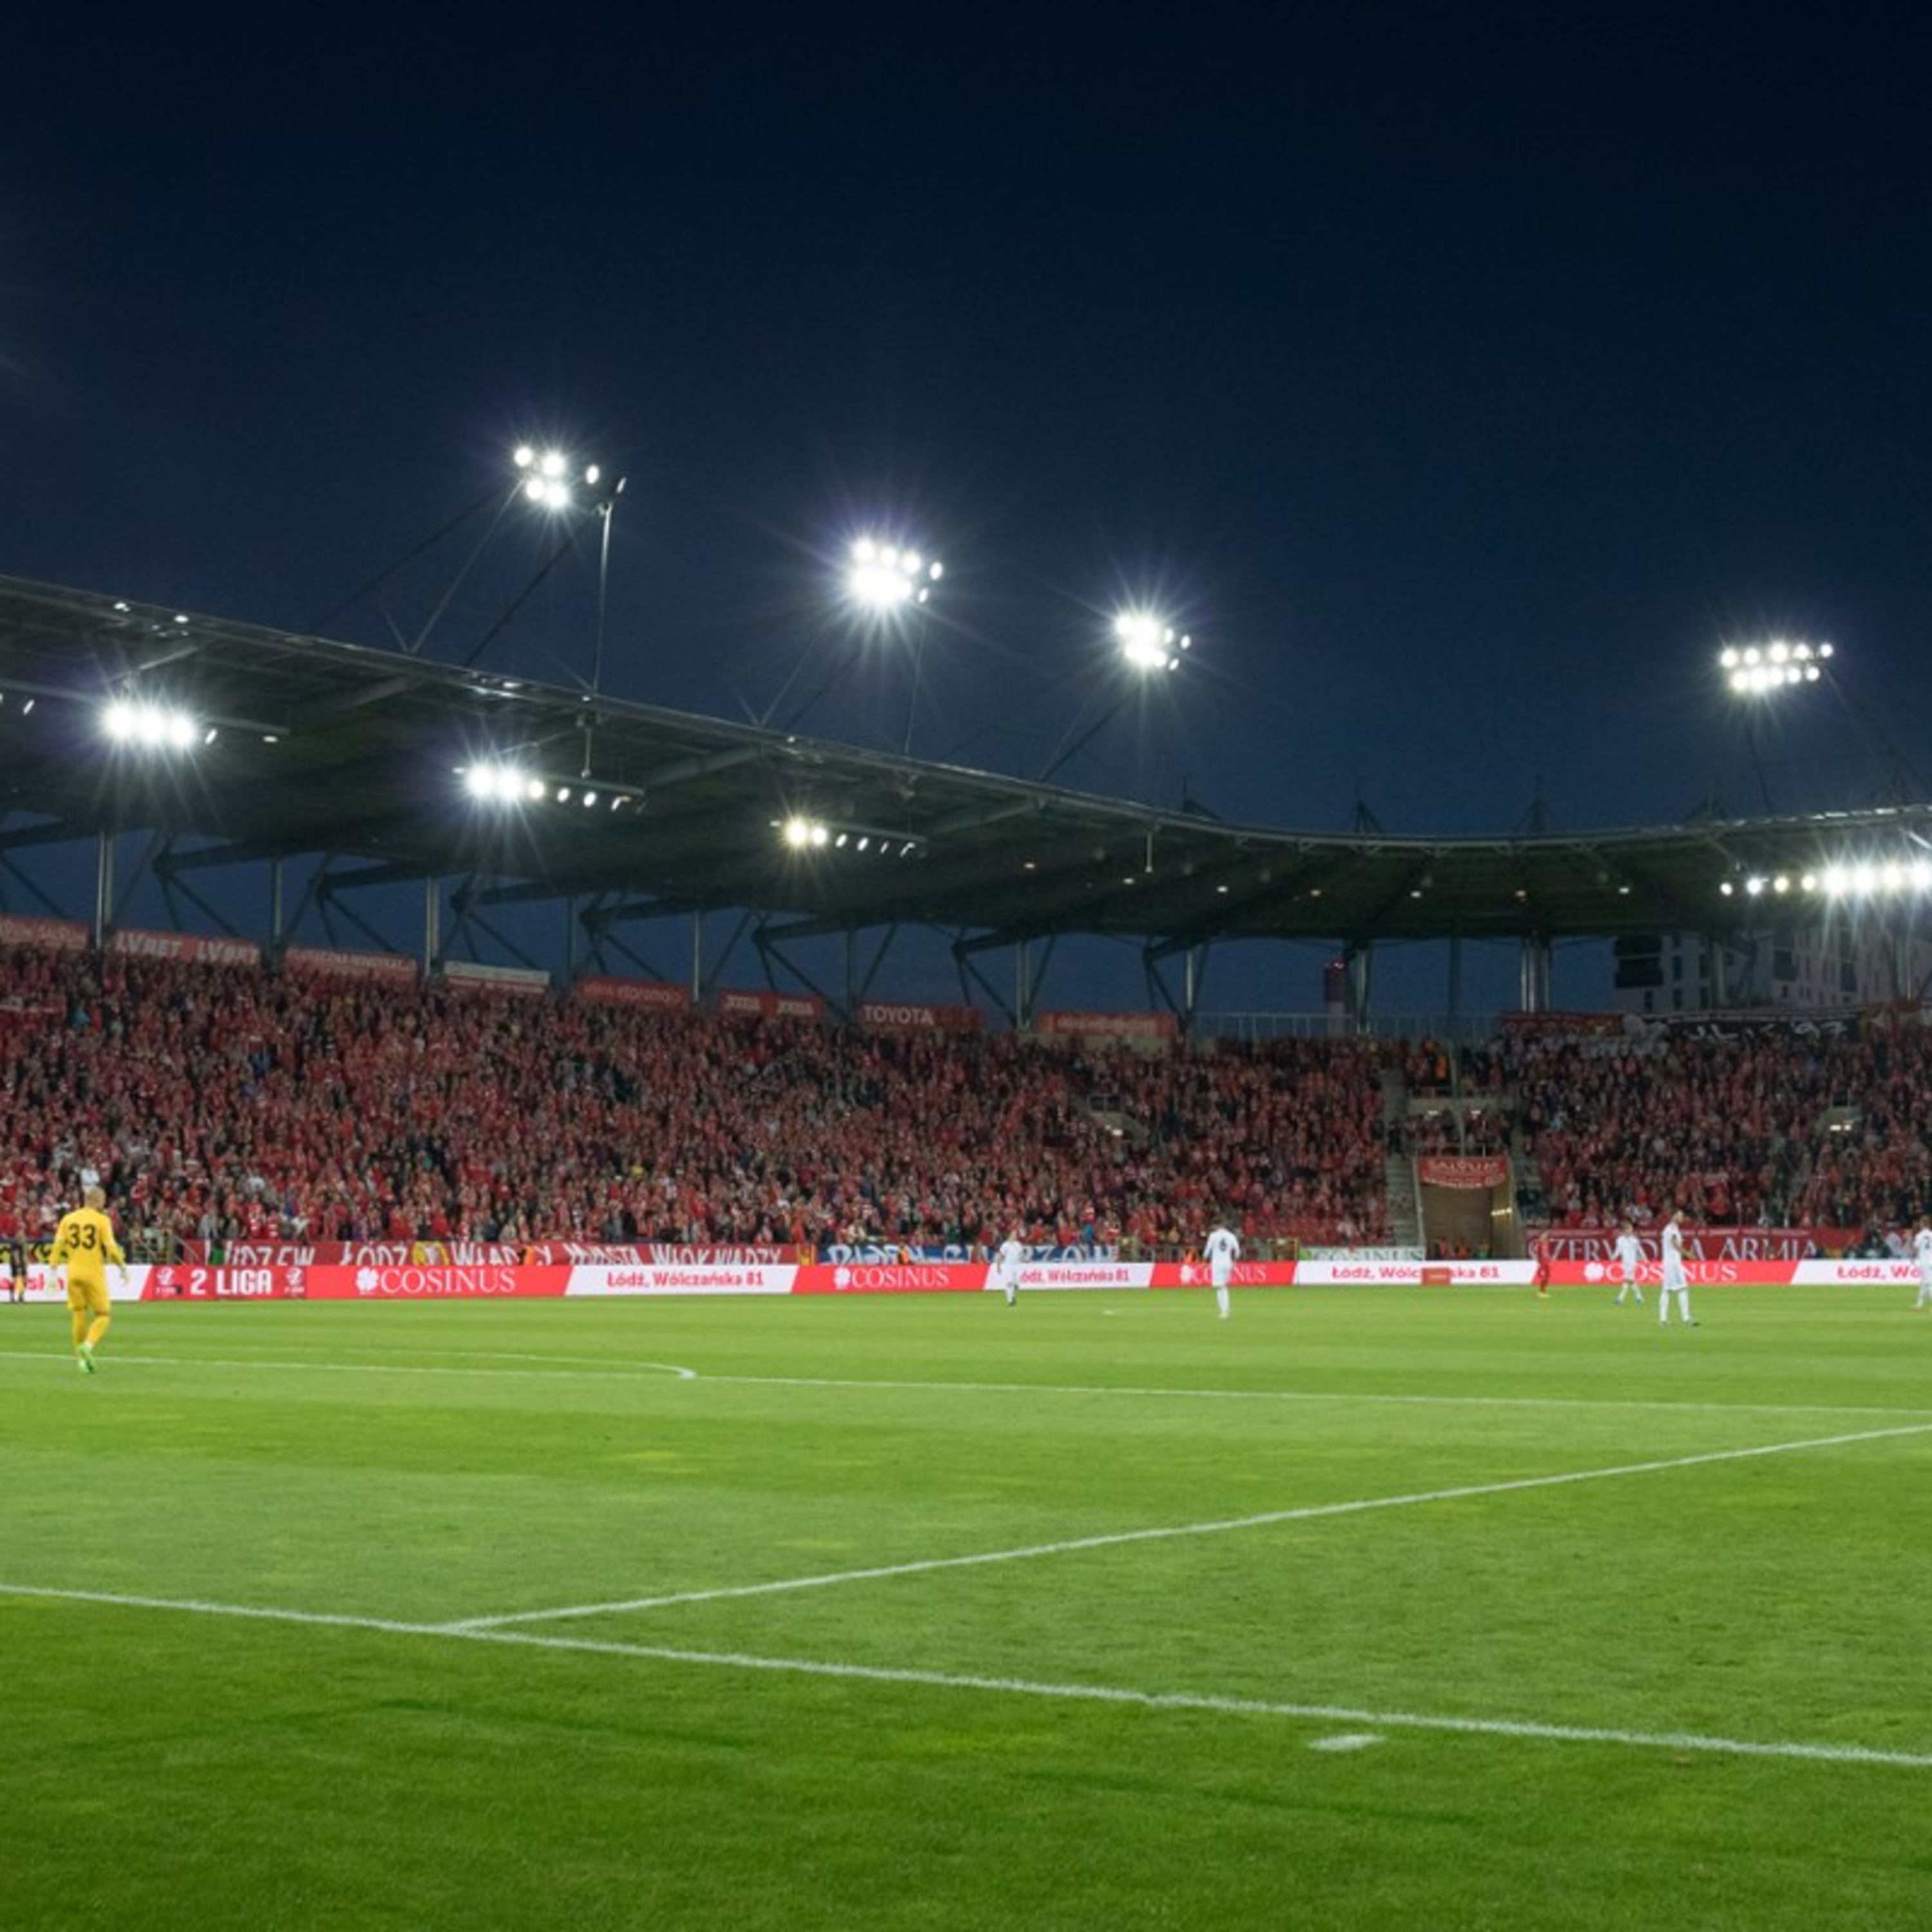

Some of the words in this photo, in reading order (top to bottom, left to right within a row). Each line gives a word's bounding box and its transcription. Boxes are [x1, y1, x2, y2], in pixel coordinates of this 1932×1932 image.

[863, 1005, 934, 1025] TOYOTA
[68, 1223, 96, 1249] 33
[191, 1269, 206, 1294] 2
[216, 1269, 271, 1294] LIGA
[381, 1269, 515, 1293] COSINUS
[747, 1271, 764, 1285] 81
[852, 1268, 949, 1287] COSINUS
[1480, 1266, 1499, 1278] 81
[1605, 1263, 1737, 1282] COSNUS
